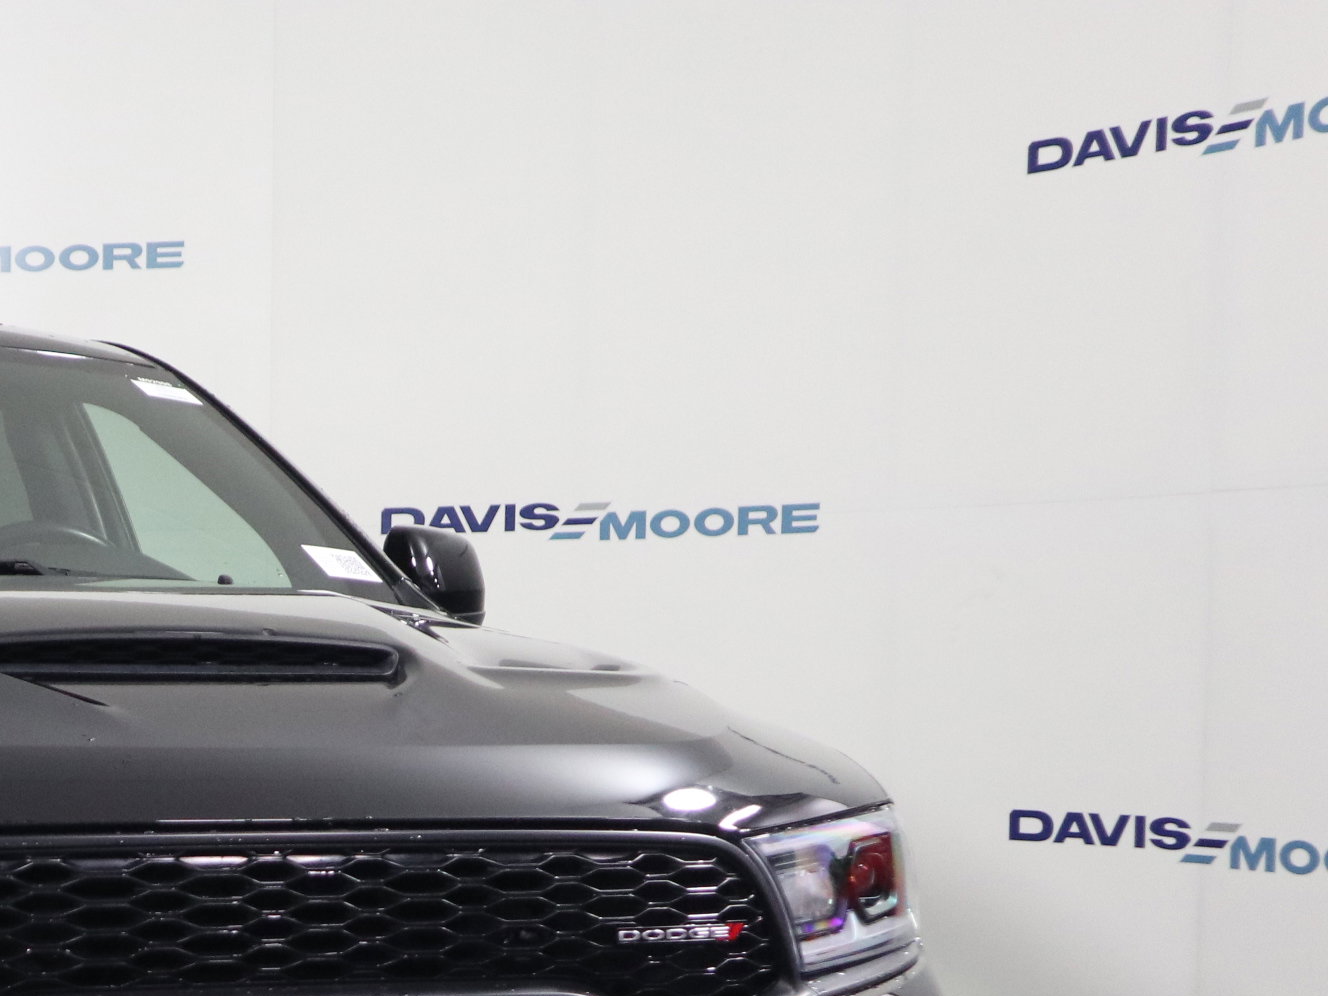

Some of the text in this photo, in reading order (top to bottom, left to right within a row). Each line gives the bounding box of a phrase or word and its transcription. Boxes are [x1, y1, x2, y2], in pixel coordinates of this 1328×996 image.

[1026, 109, 1216, 175] DAVIS
[380, 502, 822, 542] DAVIS MOORE
[1008, 809, 1328, 876] DAVIS MO
[618, 925, 731, 943] DODGE
